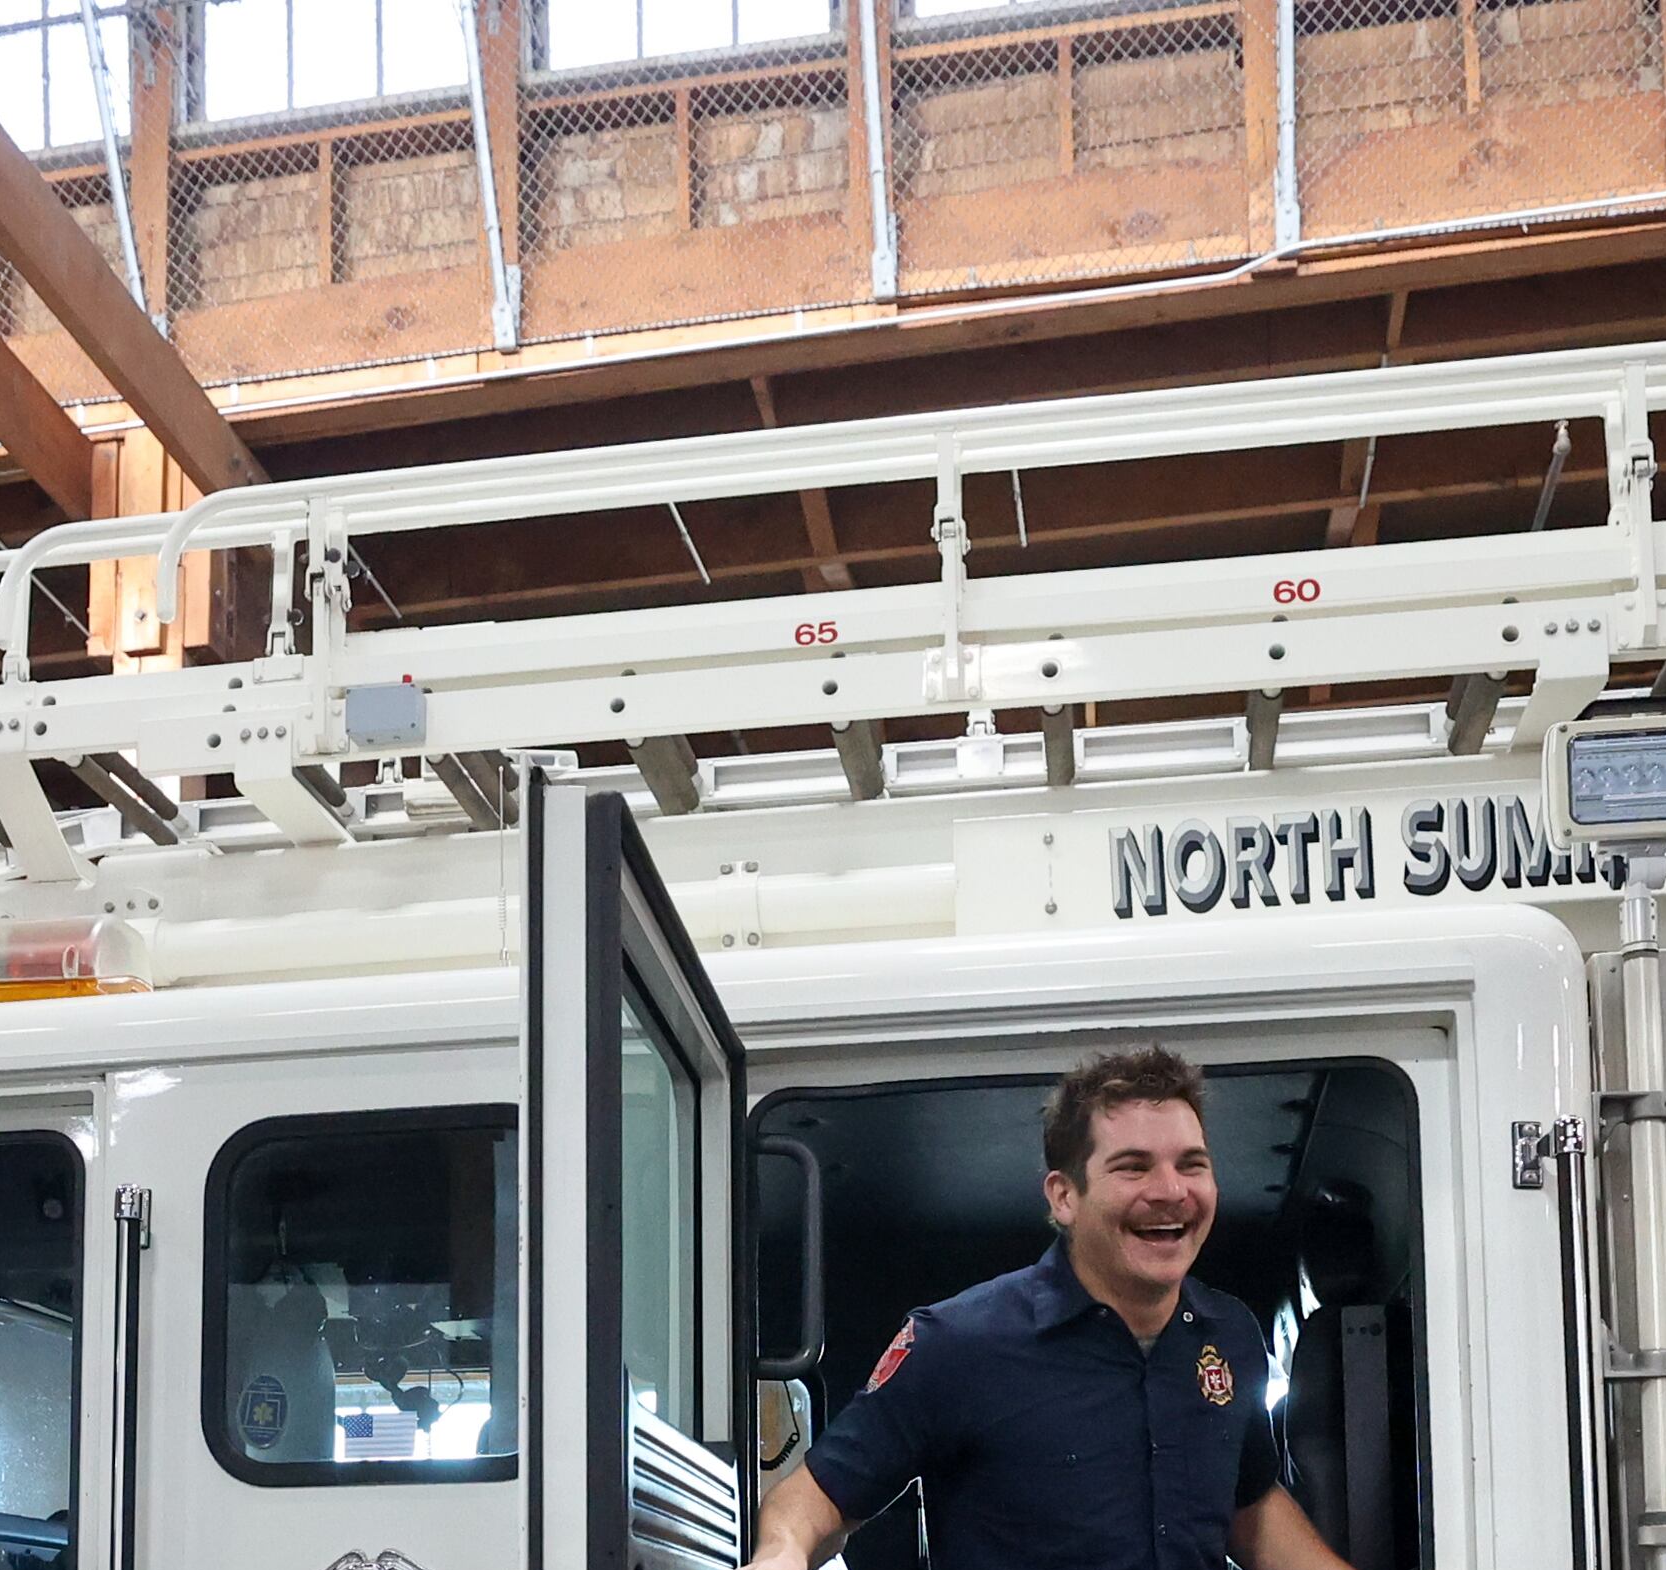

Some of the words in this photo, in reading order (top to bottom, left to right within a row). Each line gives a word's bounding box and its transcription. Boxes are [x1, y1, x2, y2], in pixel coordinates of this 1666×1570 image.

[1274, 579, 1321, 604] 60
[796, 622, 838, 646] 65
[1108, 806, 1375, 919] NORTH
